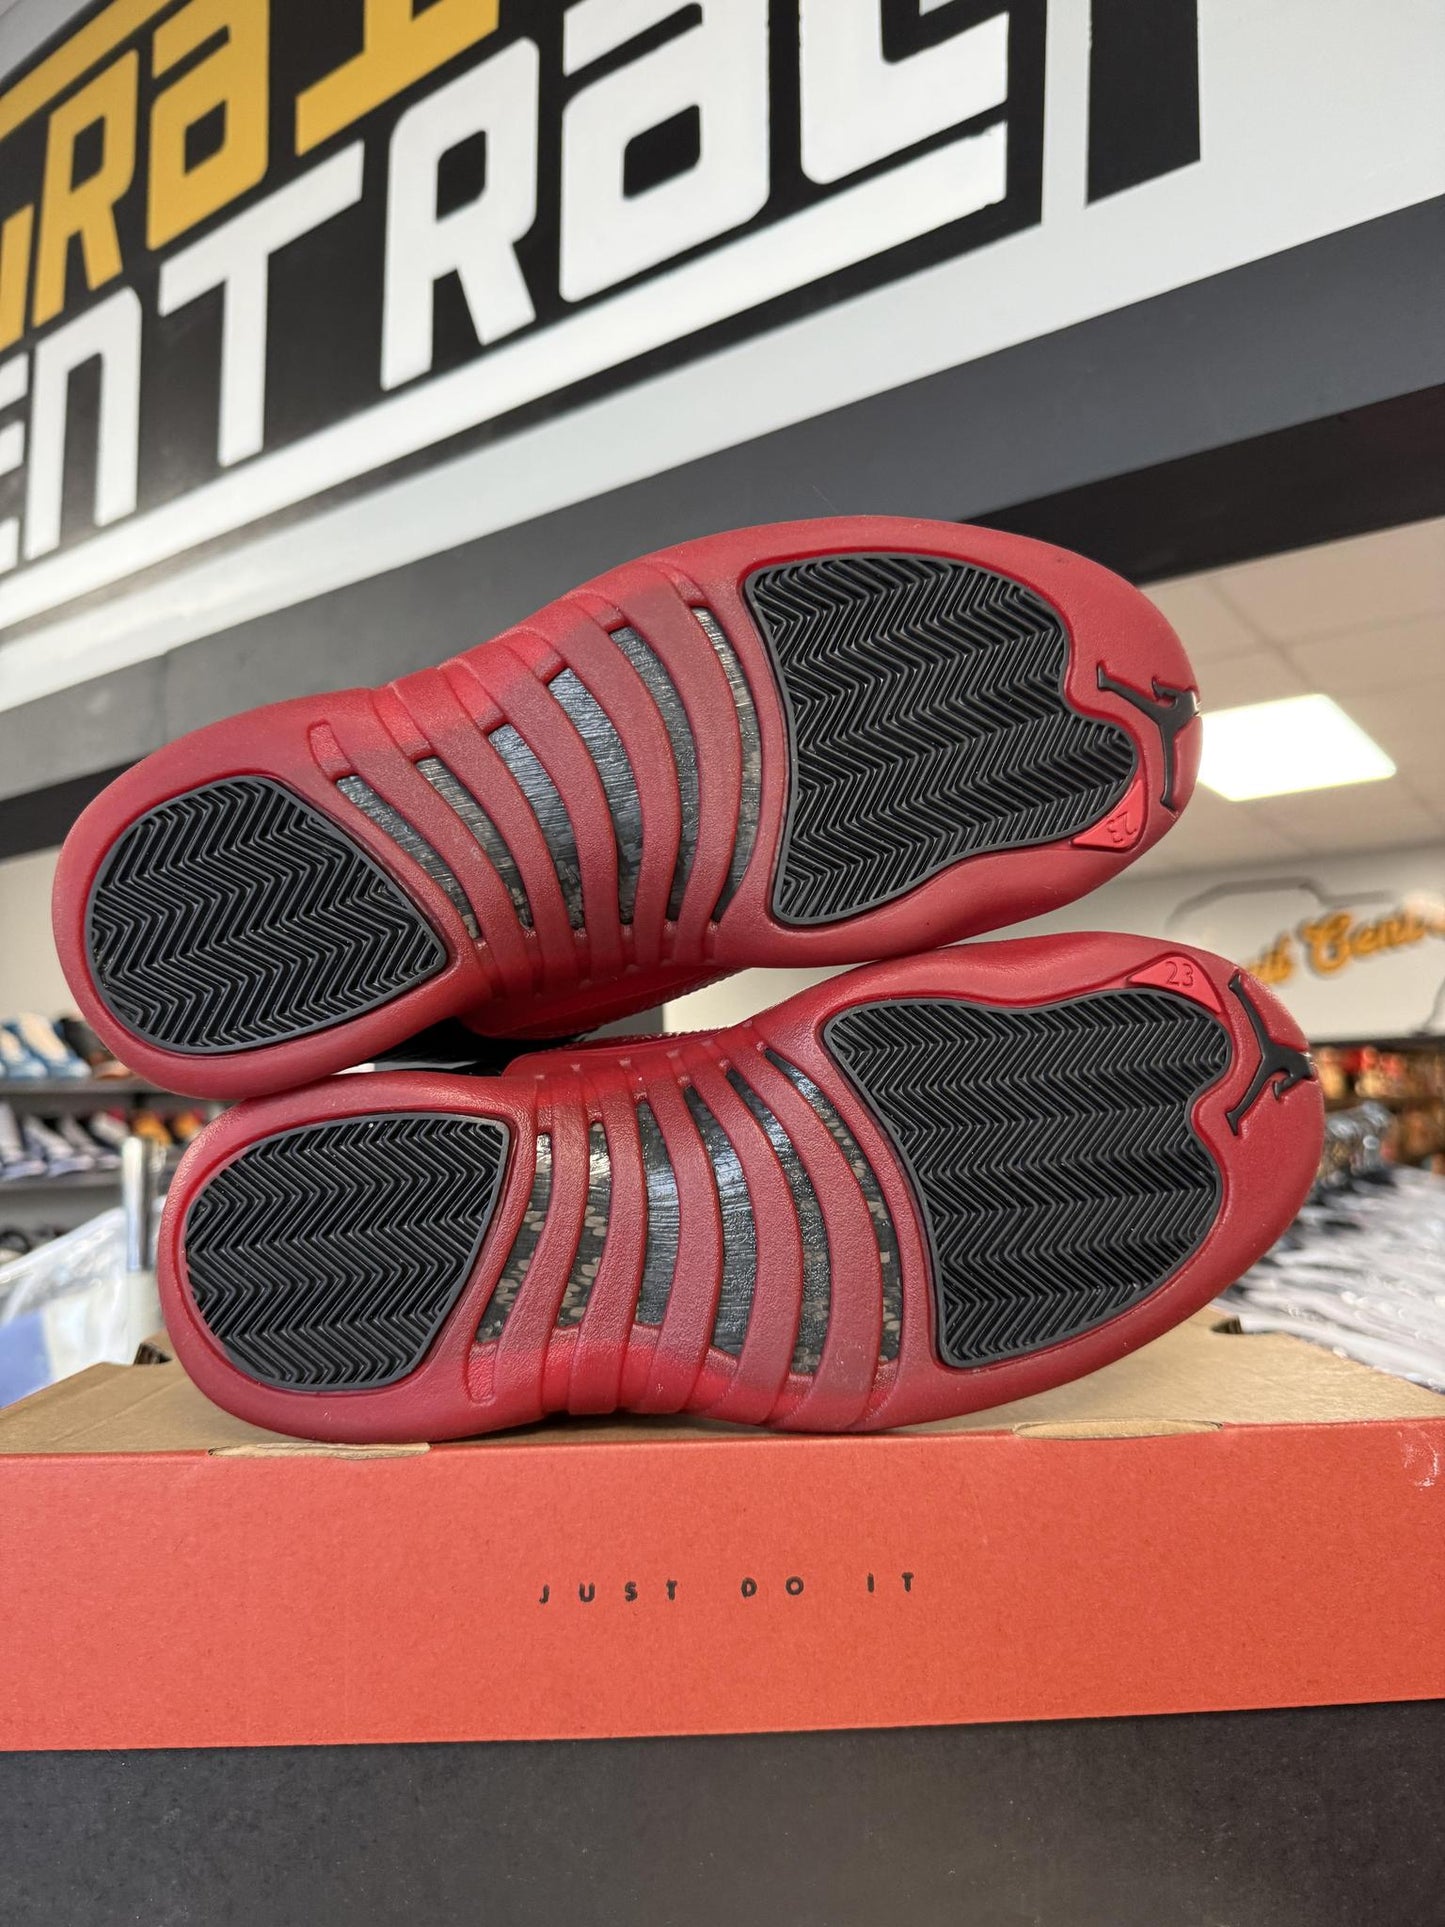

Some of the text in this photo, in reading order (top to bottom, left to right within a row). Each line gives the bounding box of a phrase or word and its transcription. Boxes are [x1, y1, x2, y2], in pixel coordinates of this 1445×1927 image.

[1164, 960, 1195, 987] 23
[538, 1571, 914, 1604] JUST DO IT
